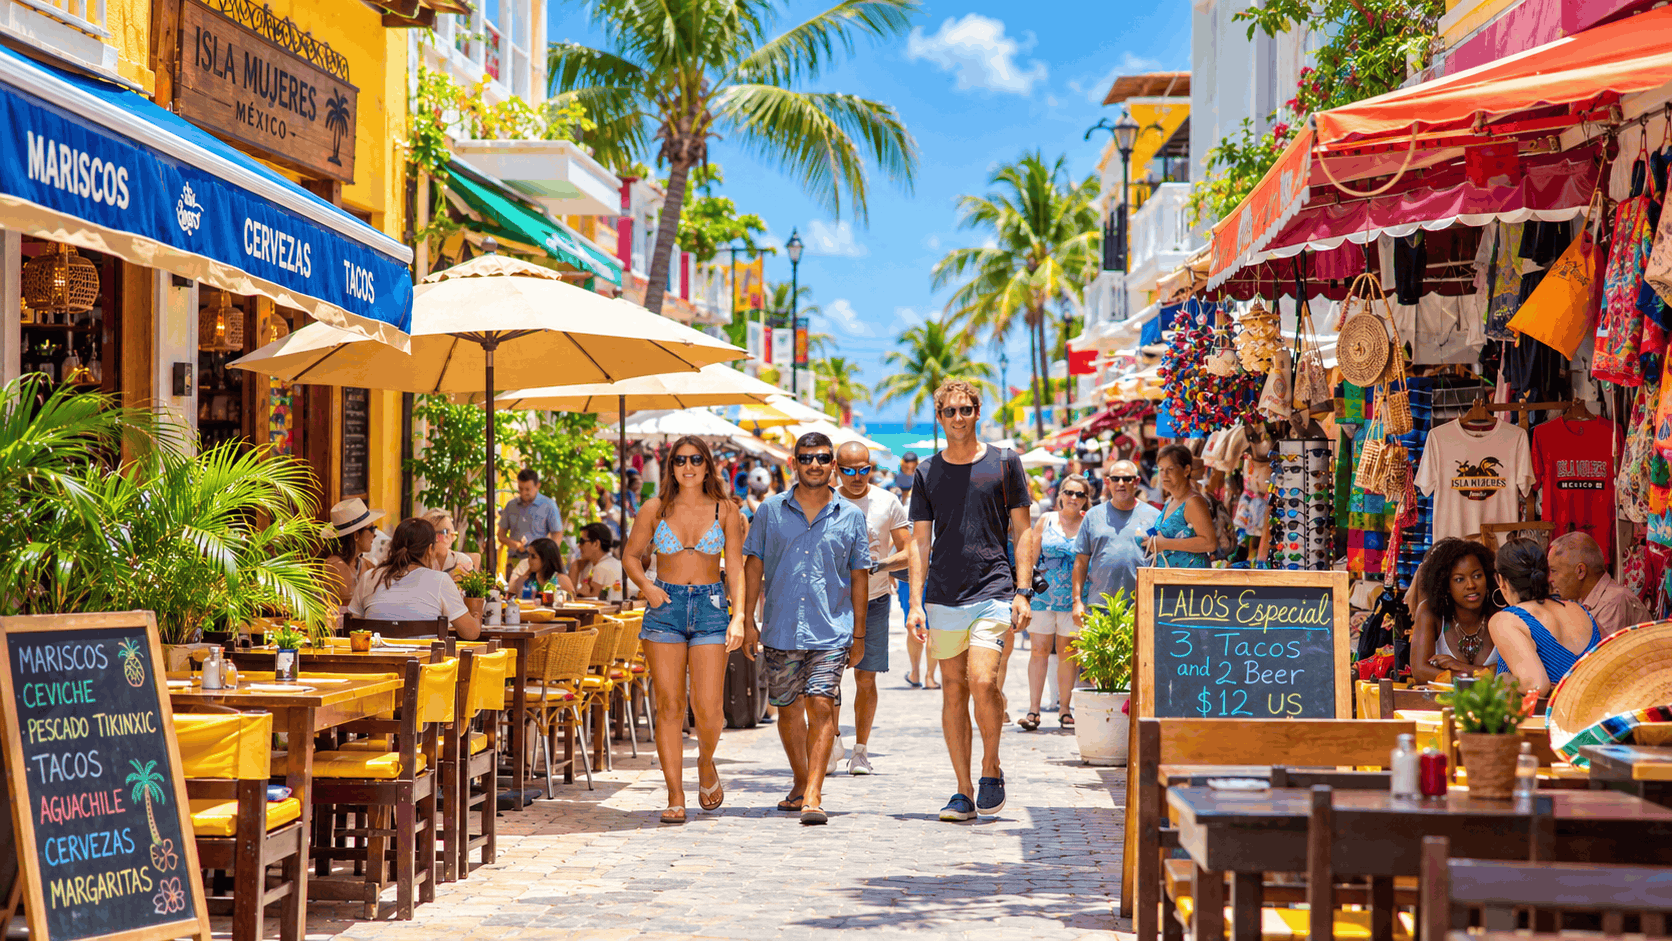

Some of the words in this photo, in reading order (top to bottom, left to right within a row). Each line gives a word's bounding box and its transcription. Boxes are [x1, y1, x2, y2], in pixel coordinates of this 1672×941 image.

[195, 26, 236, 85] ISLA
[243, 51, 316, 122] MUJERES
[235, 101, 287, 139] MÉXICO
[27, 130, 130, 210] MARISCOS
[243, 217, 311, 279] CERVEZAS
[343, 259, 375, 304] TACOS
[1451, 478, 1468, 488] ISLA
[1158, 588, 1229, 617] LALO'S
[1236, 590, 1330, 634] Especial
[18, 643, 109, 674] MARISCOS
[1170, 630, 1193, 658] 3
[1214, 632, 1301, 658] Tacos
[1177, 656, 1210, 676] and
[1215, 661, 1237, 685] 2
[1244, 660, 1305, 685] Beer
[23, 679, 96, 708] CEVICHE
[1196, 685, 1253, 718] $12
[1267, 693, 1303, 715] US
[27, 716, 89, 744] PESCADO
[92, 711, 157, 738] TIKINXIC
[31, 750, 103, 785] TACOS
[40, 788, 126, 826] AGUACHILE
[45, 827, 135, 867] CERVEZAS
[50, 866, 153, 910] MARGARITAS
